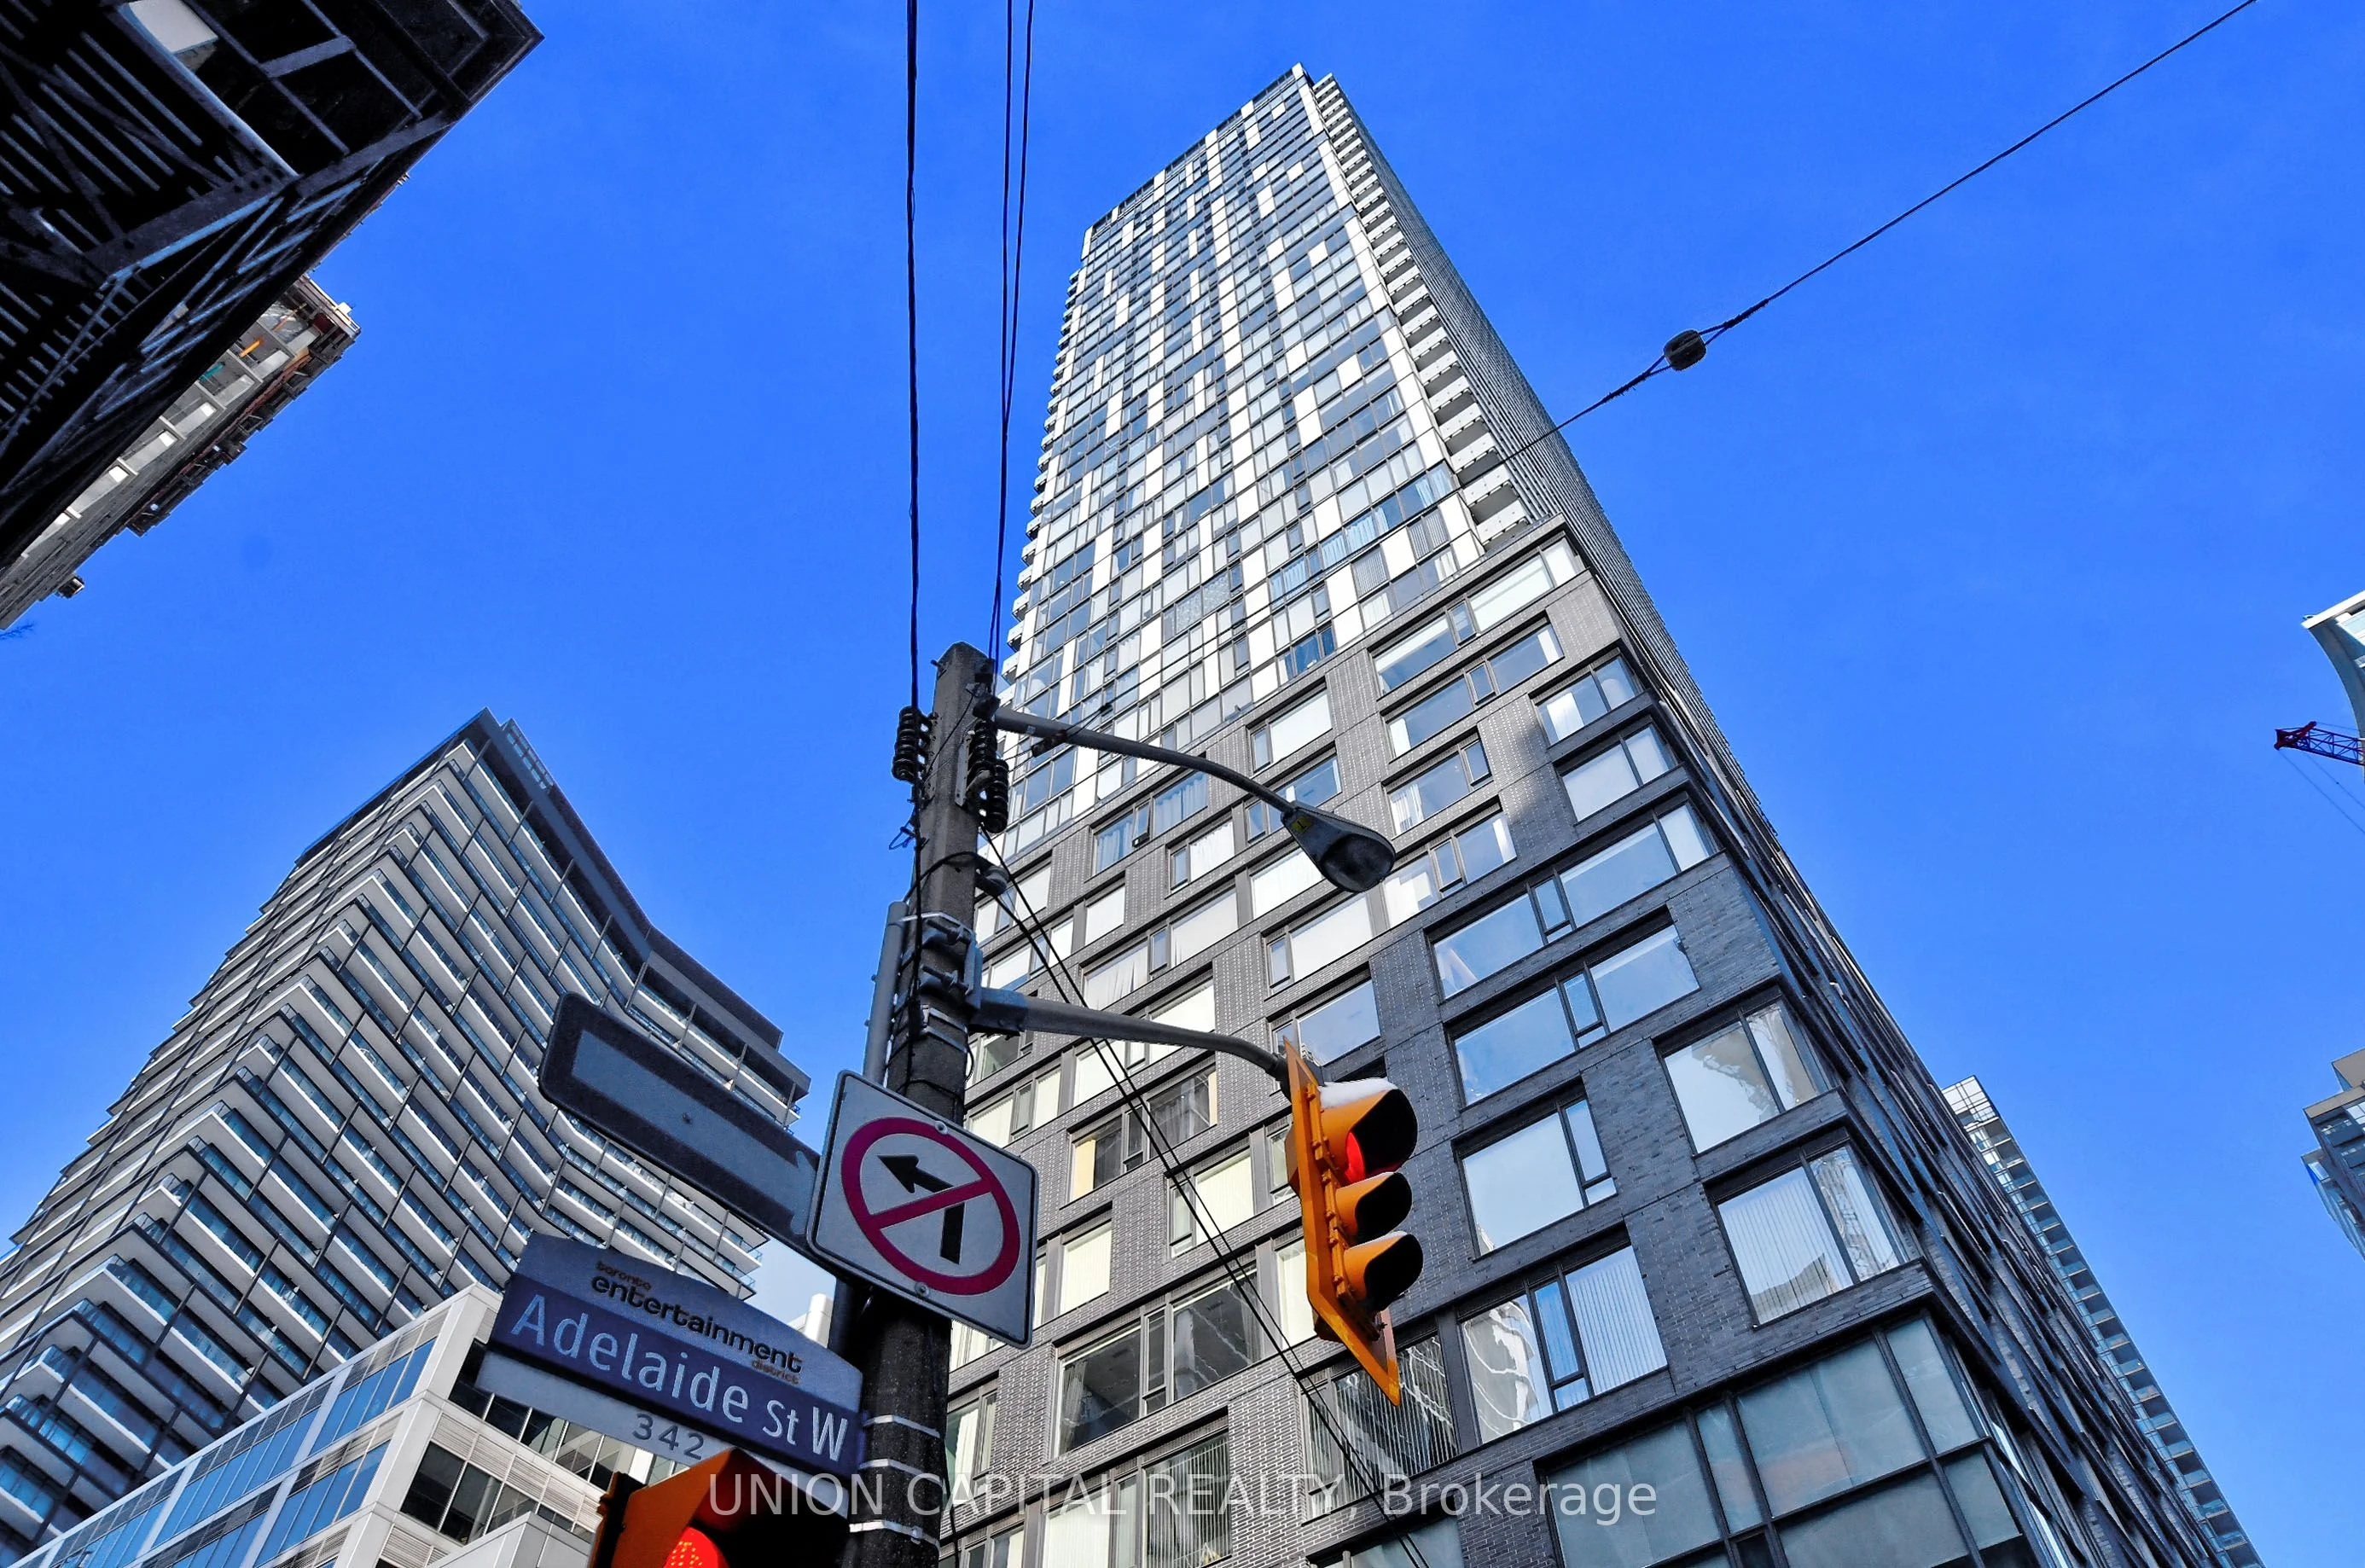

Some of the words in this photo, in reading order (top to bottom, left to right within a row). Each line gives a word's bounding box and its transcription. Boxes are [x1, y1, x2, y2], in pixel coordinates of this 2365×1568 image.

[591, 1275, 803, 1373] entertainment
[511, 1294, 750, 1423] Adelaide
[763, 1399, 799, 1446] St
[812, 1406, 849, 1462] W
[632, 1413, 705, 1461] 342
